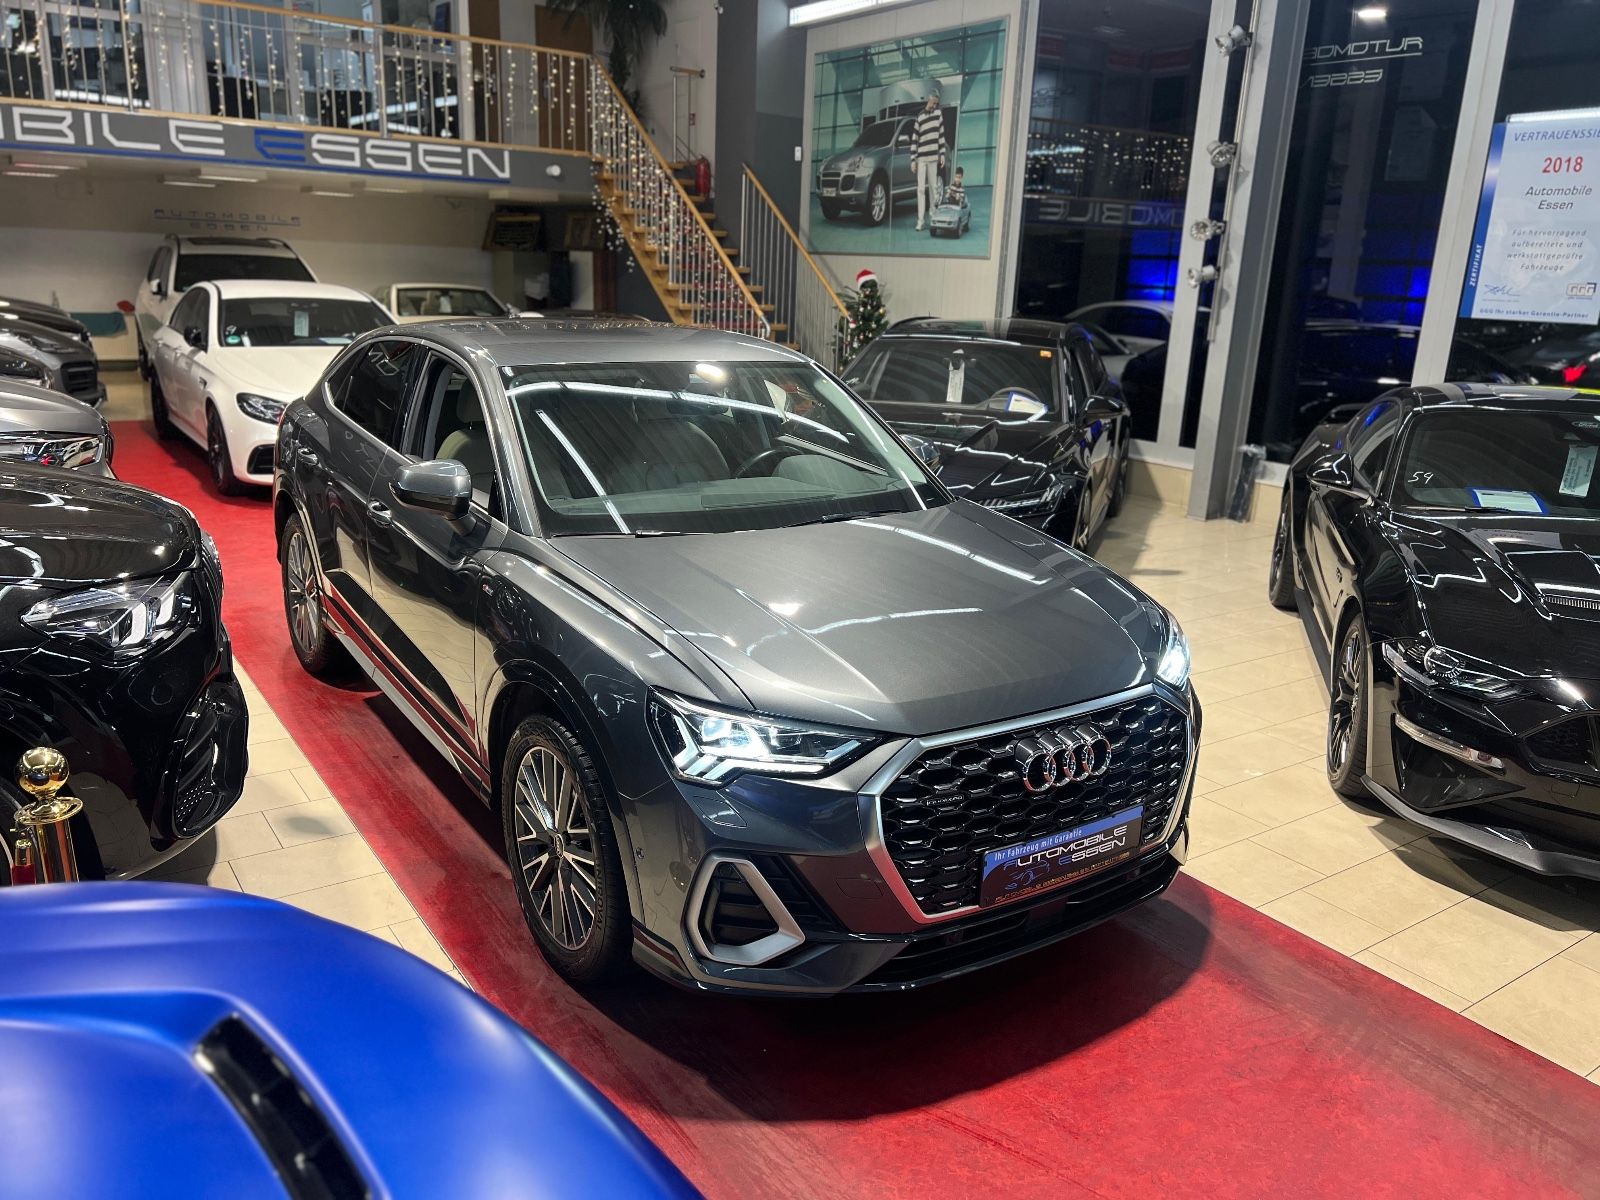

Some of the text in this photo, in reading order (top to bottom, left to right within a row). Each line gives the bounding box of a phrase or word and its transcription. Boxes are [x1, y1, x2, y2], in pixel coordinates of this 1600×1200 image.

[0, 104, 511, 180] BILE ESSEN
[1542, 156, 1584, 173] 2018
[1525, 185, 1593, 197] Automobile
[153, 208, 301, 223] AUTOMOBILE
[1537, 199, 1574, 210] Essen
[1566, 240, 1583, 248] und
[1469, 244, 1483, 287] ZERTIFIKAT
[995, 829, 1082, 862] Ihr Fahrzeug mit Garantie
[1003, 825, 1128, 870] AUTOMOBILE
[1059, 836, 1126, 866] ESSEN
